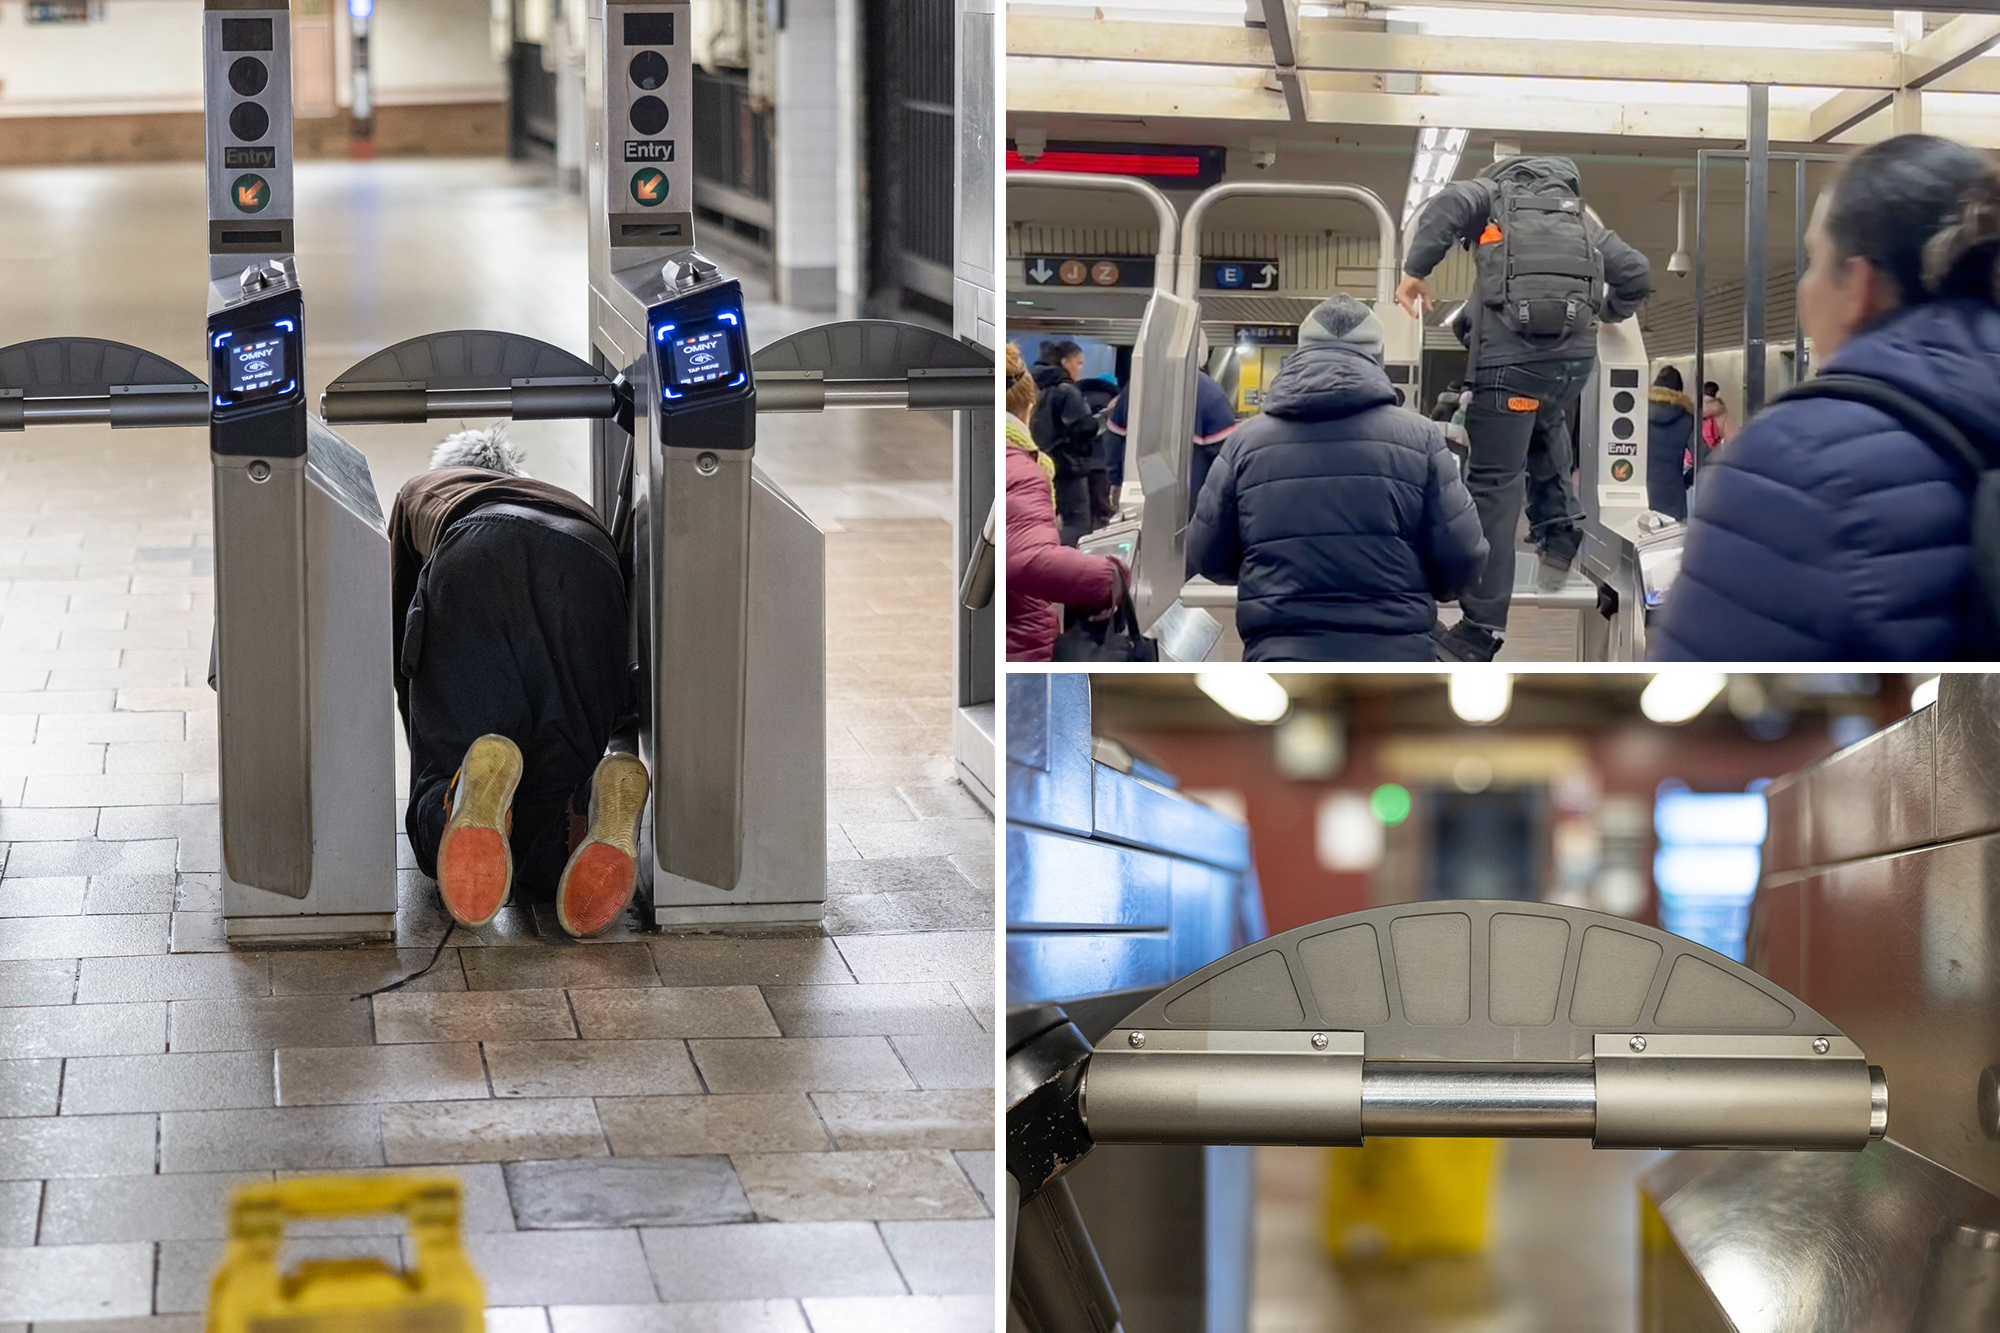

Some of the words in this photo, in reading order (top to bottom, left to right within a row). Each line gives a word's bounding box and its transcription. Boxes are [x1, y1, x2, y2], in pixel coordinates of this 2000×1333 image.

[226, 148, 273, 167] Entry
[626, 142, 672, 161] Entry
[1067, 265, 1078, 280] J
[1098, 265, 1112, 280] Z
[1224, 267, 1237, 282] E
[683, 340, 718, 354] OMNY
[239, 348, 273, 361] OMNY
[254, 370, 273, 379] HERE
[687, 366, 701, 374] TAP
[701, 362, 719, 371] HERE
[1608, 443, 1637, 456] Entry
